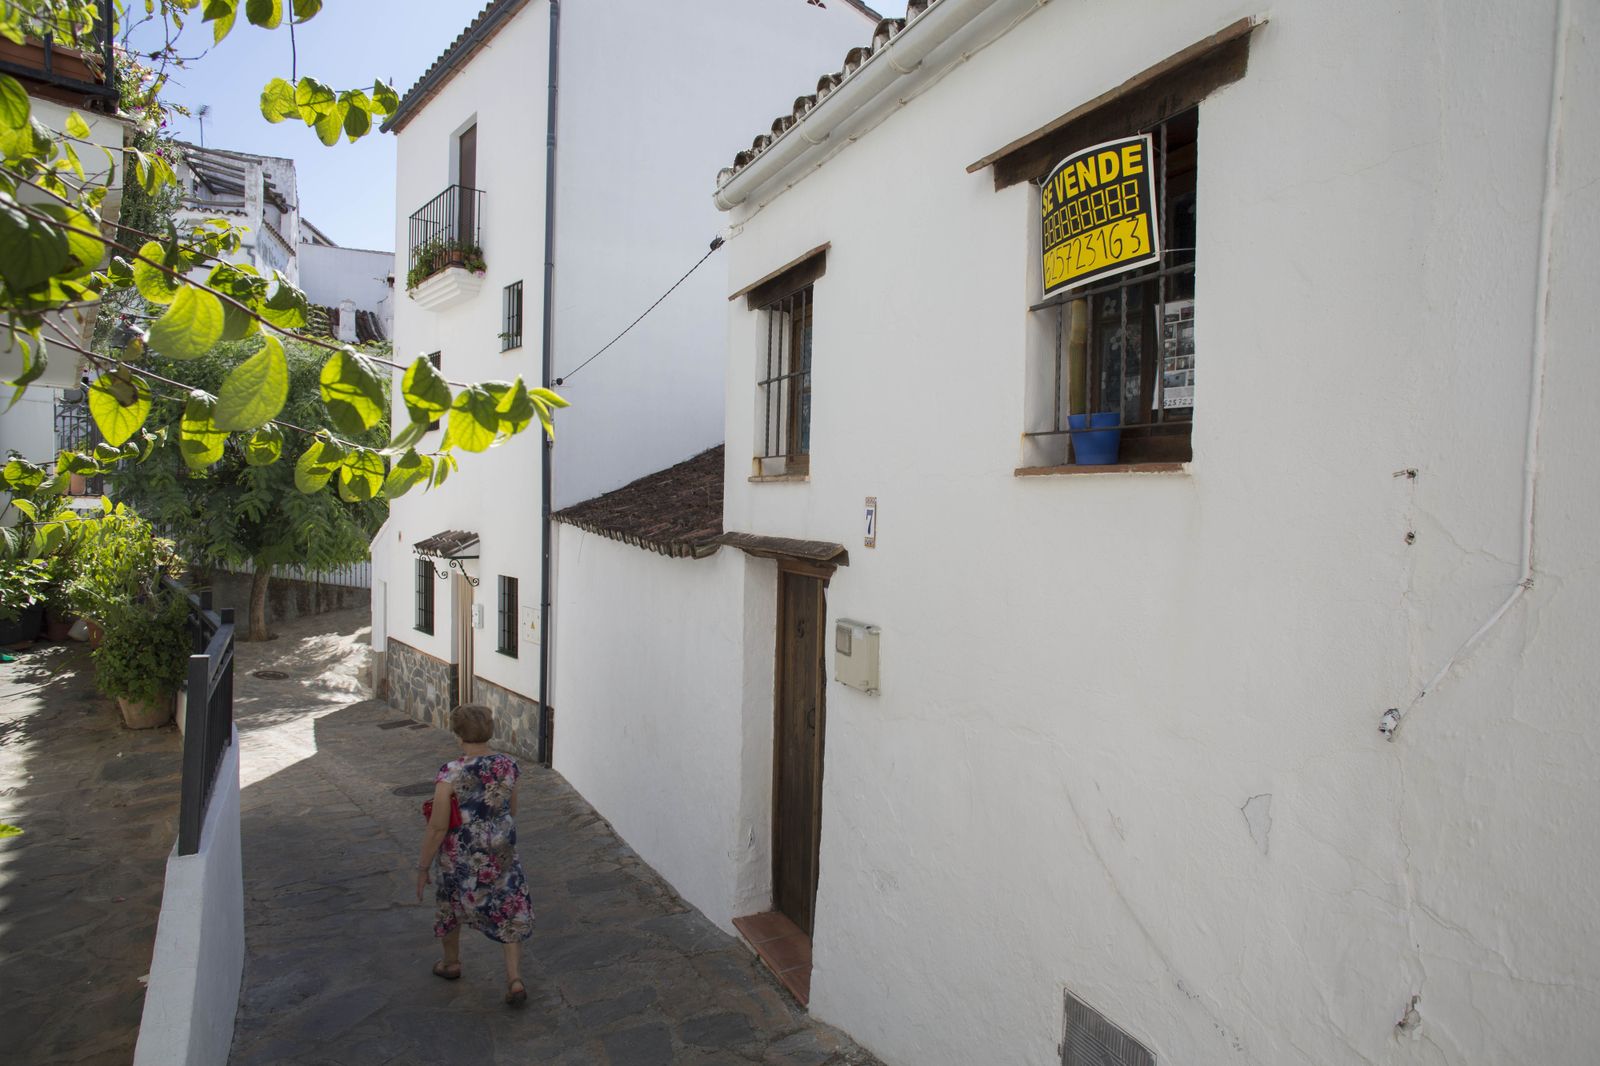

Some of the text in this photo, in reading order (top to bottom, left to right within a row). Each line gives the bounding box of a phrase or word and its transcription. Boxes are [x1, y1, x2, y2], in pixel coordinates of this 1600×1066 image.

[1043, 144, 1143, 217] SE VENDE
[866, 509, 873, 535] 7
